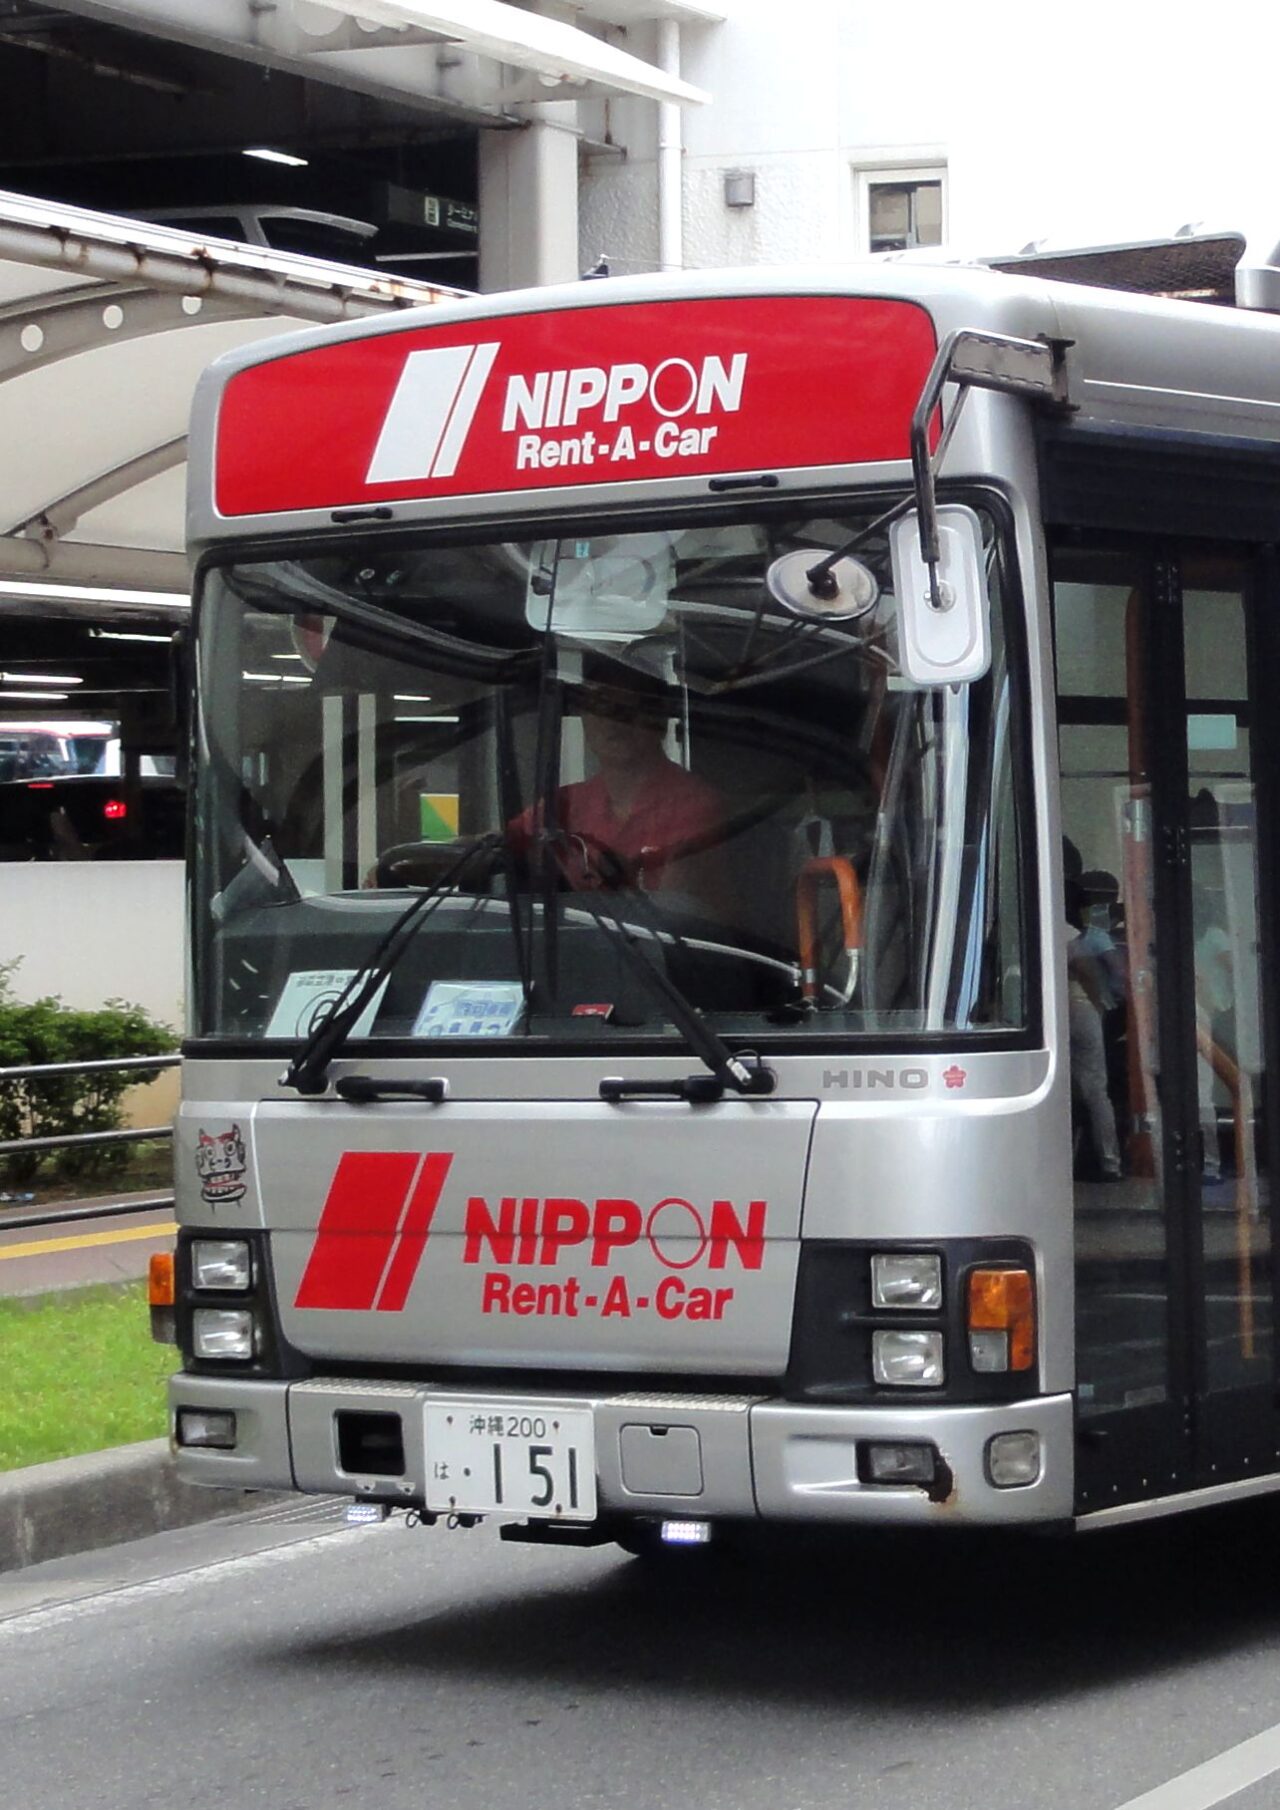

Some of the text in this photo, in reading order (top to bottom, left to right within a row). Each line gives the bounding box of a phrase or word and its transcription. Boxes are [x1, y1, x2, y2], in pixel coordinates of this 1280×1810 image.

[501, 353, 748, 432] NIPPON
[516, 421, 718, 470] Rent-A-Car
[822, 1068, 929, 1089] HINO
[463, 1197, 767, 1270] NIPPON
[481, 1272, 734, 1320] Rent-A-Car
[433, 1462, 450, 1480] は
